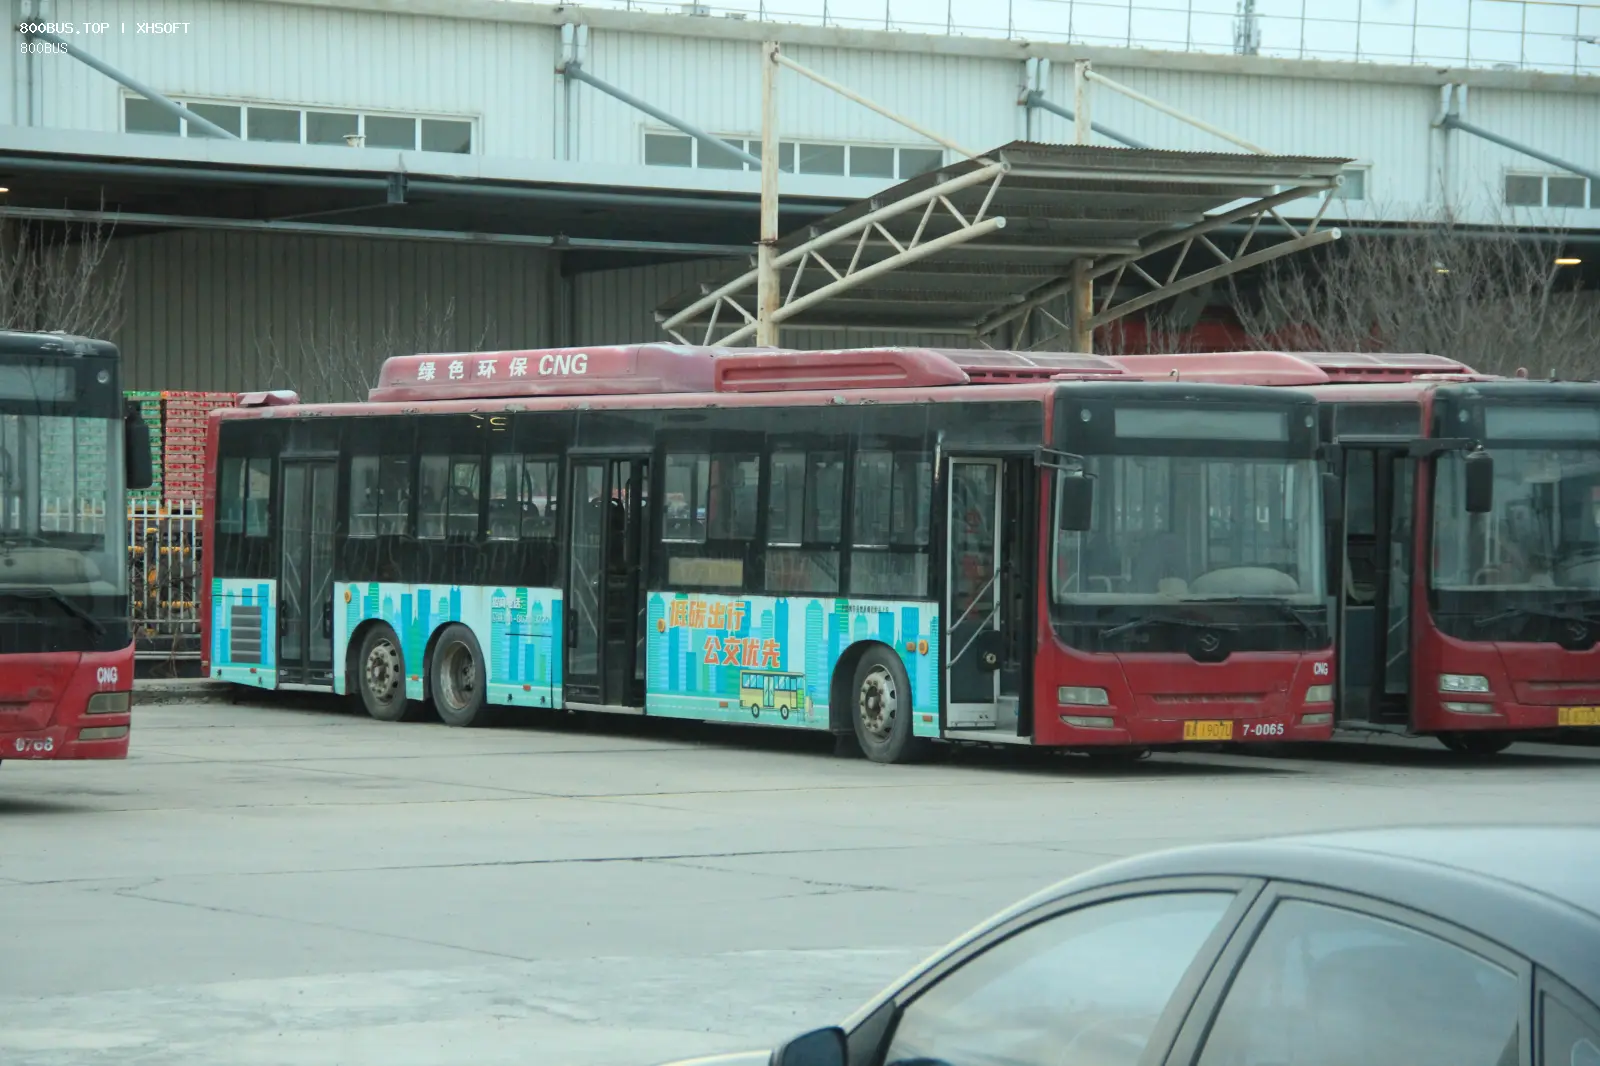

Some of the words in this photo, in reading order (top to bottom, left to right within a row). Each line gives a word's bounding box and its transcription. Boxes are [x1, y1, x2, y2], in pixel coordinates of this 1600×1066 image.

[417, 357, 528, 381] 绿色环保
[538, 353, 588, 376] CNG
[669, 599, 746, 631] 低碳出行
[703, 636, 781, 667] 公交优先
[97, 666, 118, 683] CNG
[1314, 662, 1328, 676] CNG
[1242, 723, 1284, 737] 7-0065
